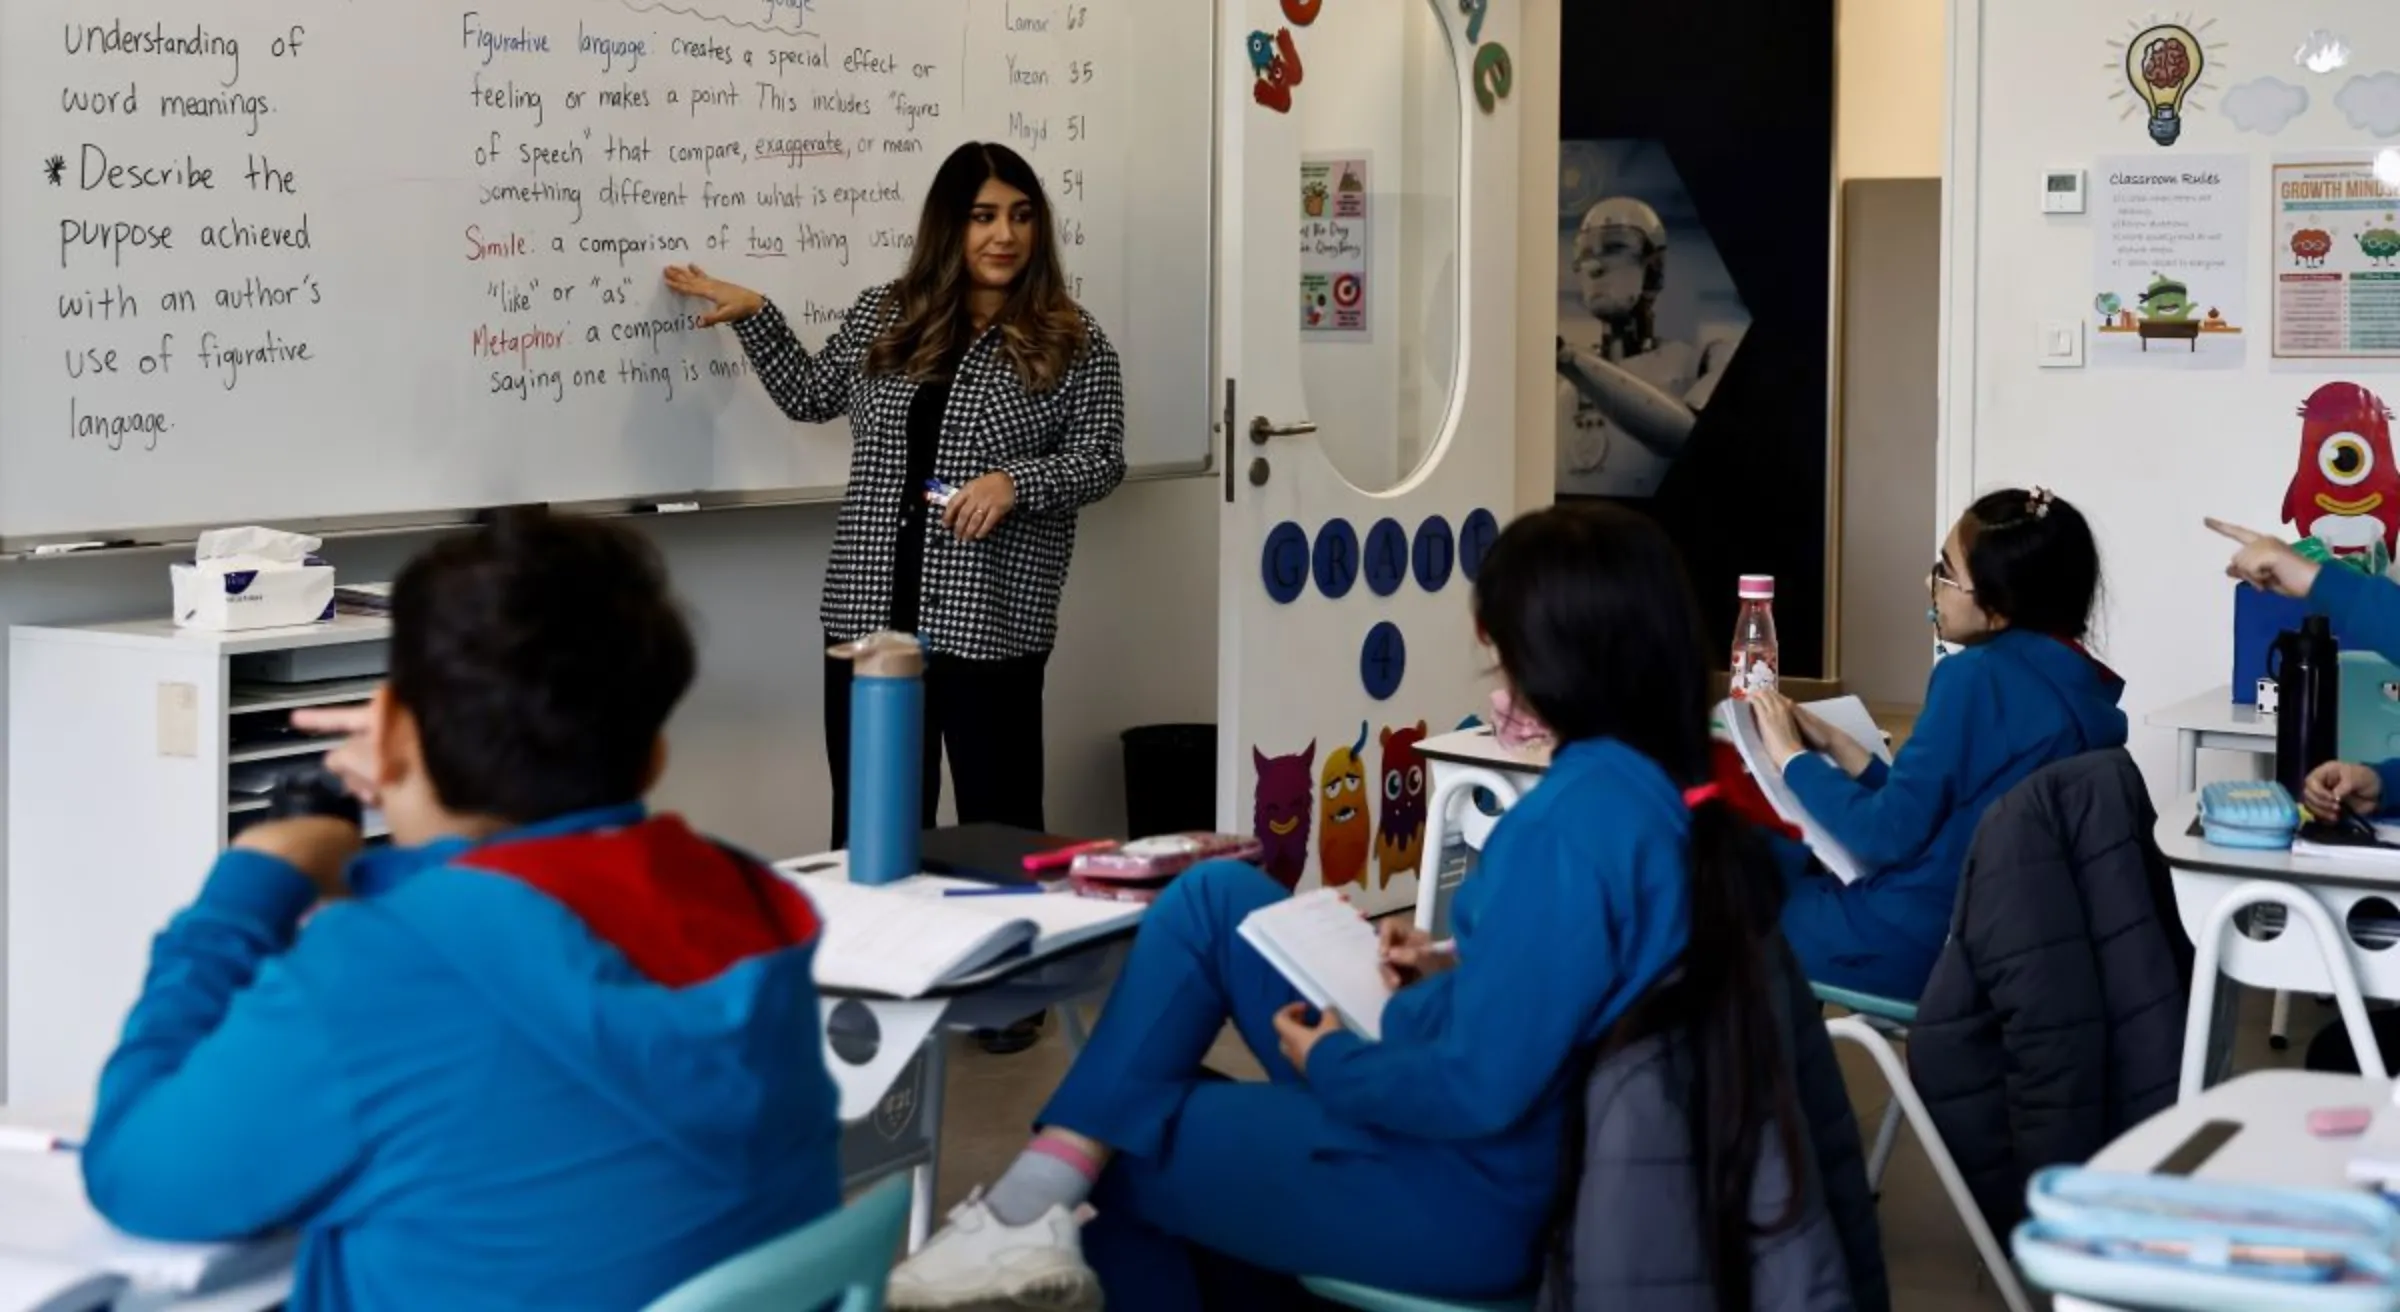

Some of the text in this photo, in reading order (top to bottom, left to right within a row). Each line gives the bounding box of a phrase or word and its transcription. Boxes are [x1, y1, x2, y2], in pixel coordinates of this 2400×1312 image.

[271, 25, 305, 58] of
[462, 11, 551, 66] Figurative
[671, 35, 733, 65] creates
[742, 50, 753, 67] a
[768, 42, 830, 78] special
[843, 47, 899, 74] effect
[912, 64, 937, 79] or
[1069, 60, 1094, 84] 35
[62, 82, 278, 137] word meanings.
[470, 71, 544, 128] feeling
[564, 91, 587, 109] or
[598, 81, 651, 110] makes
[666, 89, 679, 104] a
[755, 80, 798, 113] This
[812, 87, 872, 116] includes
[1066, 114, 1086, 141] 51
[80, 143, 297, 194] Describe the
[474, 131, 501, 166] of
[603, 133, 651, 163] that
[668, 139, 748, 176] compare,
[856, 137, 875, 154] or
[882, 137, 923, 154] mean
[478, 179, 583, 225] something
[598, 175, 688, 207] different
[701, 180, 746, 209] from
[756, 182, 804, 208] what
[812, 184, 828, 206] is
[1062, 168, 1084, 201] 54
[2108, 169, 2221, 185] Classroom Rules
[2281, 180, 2342, 199] GROWTH
[60, 213, 312, 268] purpose achieved
[551, 236, 565, 254] a
[578, 233, 690, 268] comparison
[705, 223, 730, 254] of
[746, 226, 786, 254] two
[795, 223, 850, 268] thing
[58, 273, 322, 320] with an author's
[552, 284, 576, 301] or
[585, 328, 601, 344] a
[611, 313, 707, 356] compariso
[138, 332, 174, 374] of
[197, 330, 316, 391] figurative
[490, 356, 754, 403] saying one thing is anot
[69, 396, 176, 452] language.
